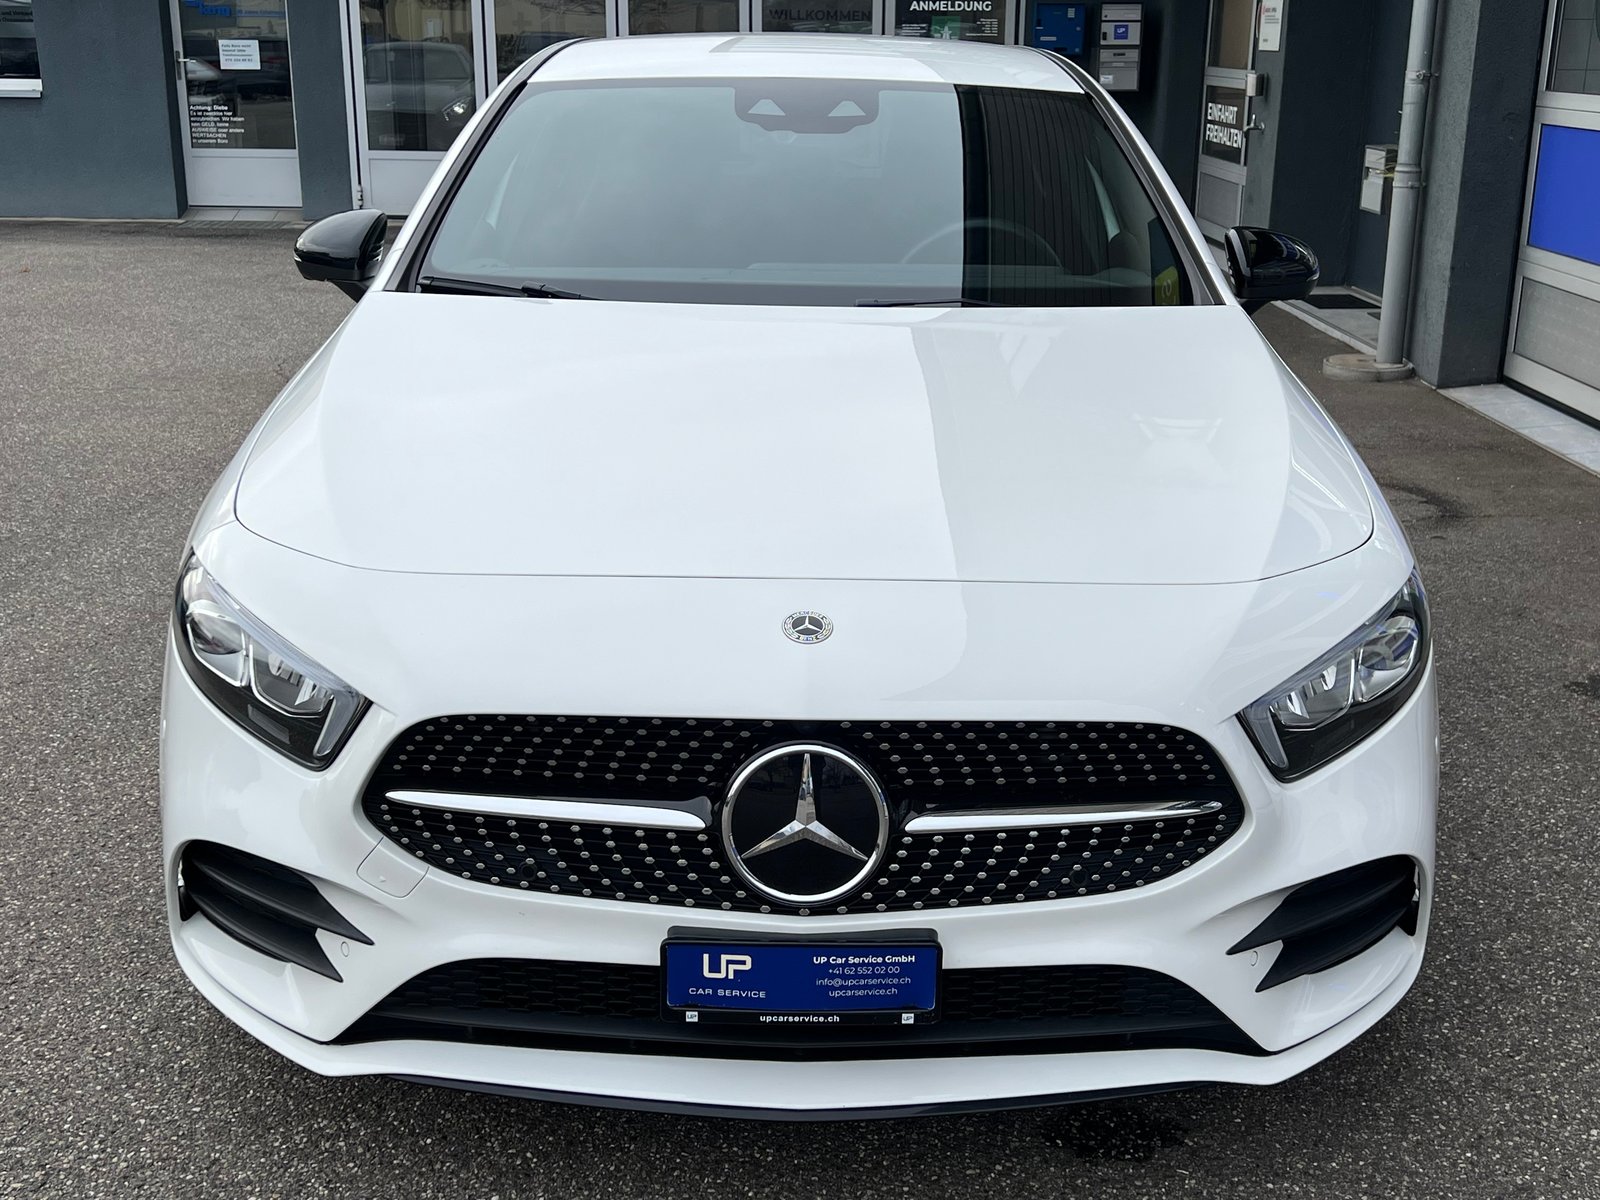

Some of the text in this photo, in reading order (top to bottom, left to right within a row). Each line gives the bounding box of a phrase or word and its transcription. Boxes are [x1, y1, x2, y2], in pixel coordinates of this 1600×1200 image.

[909, 1, 992, 11] ANMELDUNG
[769, 9, 871, 21] WILLKOMMEN
[1207, 102, 1238, 125] EINFAHRT
[1205, 123, 1243, 149] FREIHALTEN
[813, 954, 916, 964] UP Car Service GmbH
[702, 953, 752, 979] UP
[828, 966, 900, 975] +41 62 552 02 00
[815, 976, 912, 987] info@upcarservice.ch
[688, 987, 767, 999] CAR SERVICE
[828, 987, 898, 998] upcarservice.ch
[759, 1014, 840, 1024] upcarservice.ch
